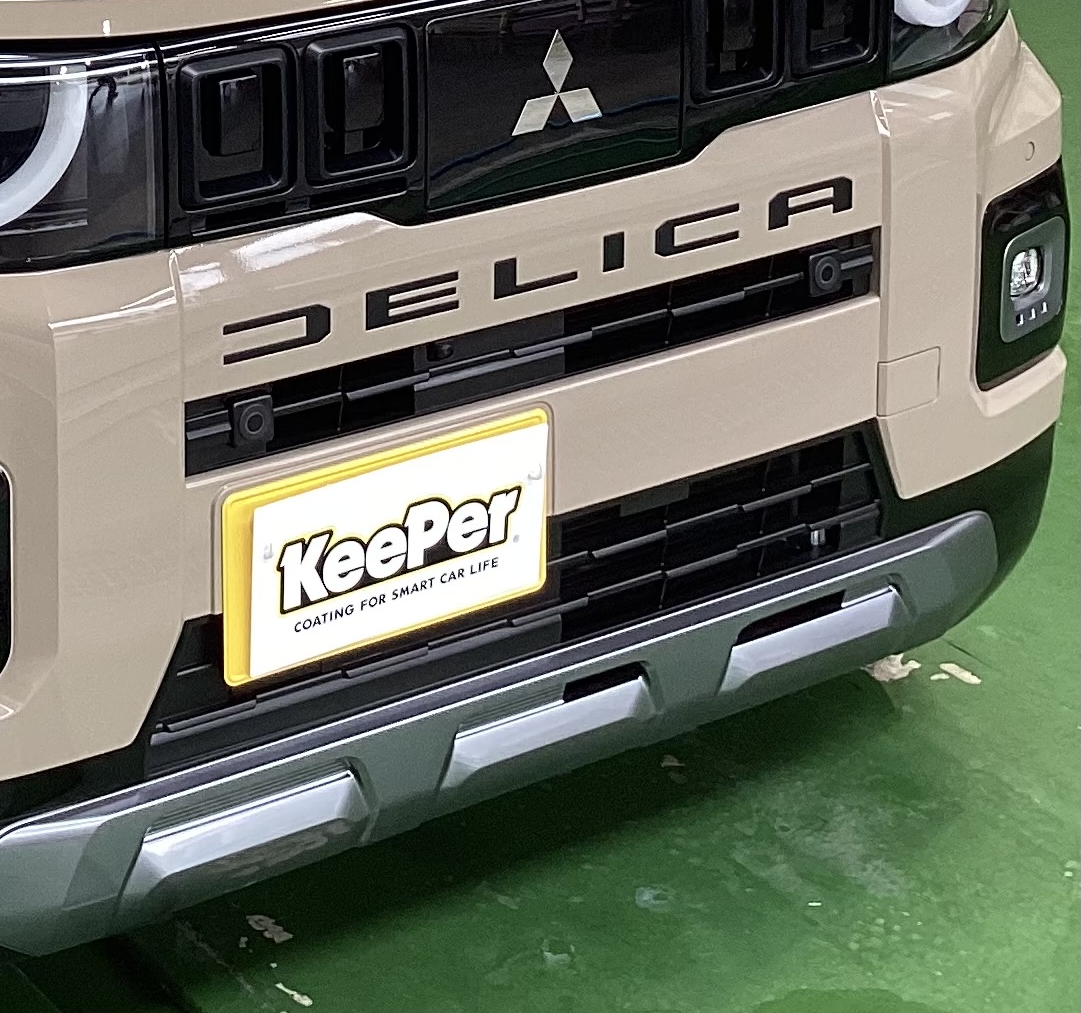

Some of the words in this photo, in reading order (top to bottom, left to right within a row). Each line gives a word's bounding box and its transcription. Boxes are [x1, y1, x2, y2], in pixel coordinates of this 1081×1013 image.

[223, 177, 853, 365] DELICA
[277, 485, 522, 615] KeePer
[294, 603, 355, 633] COATING
[360, 593, 387, 611] FOR
[391, 576, 436, 601] SMART
[439, 567, 466, 585] CAR
[469, 556, 500, 575] LIFE
